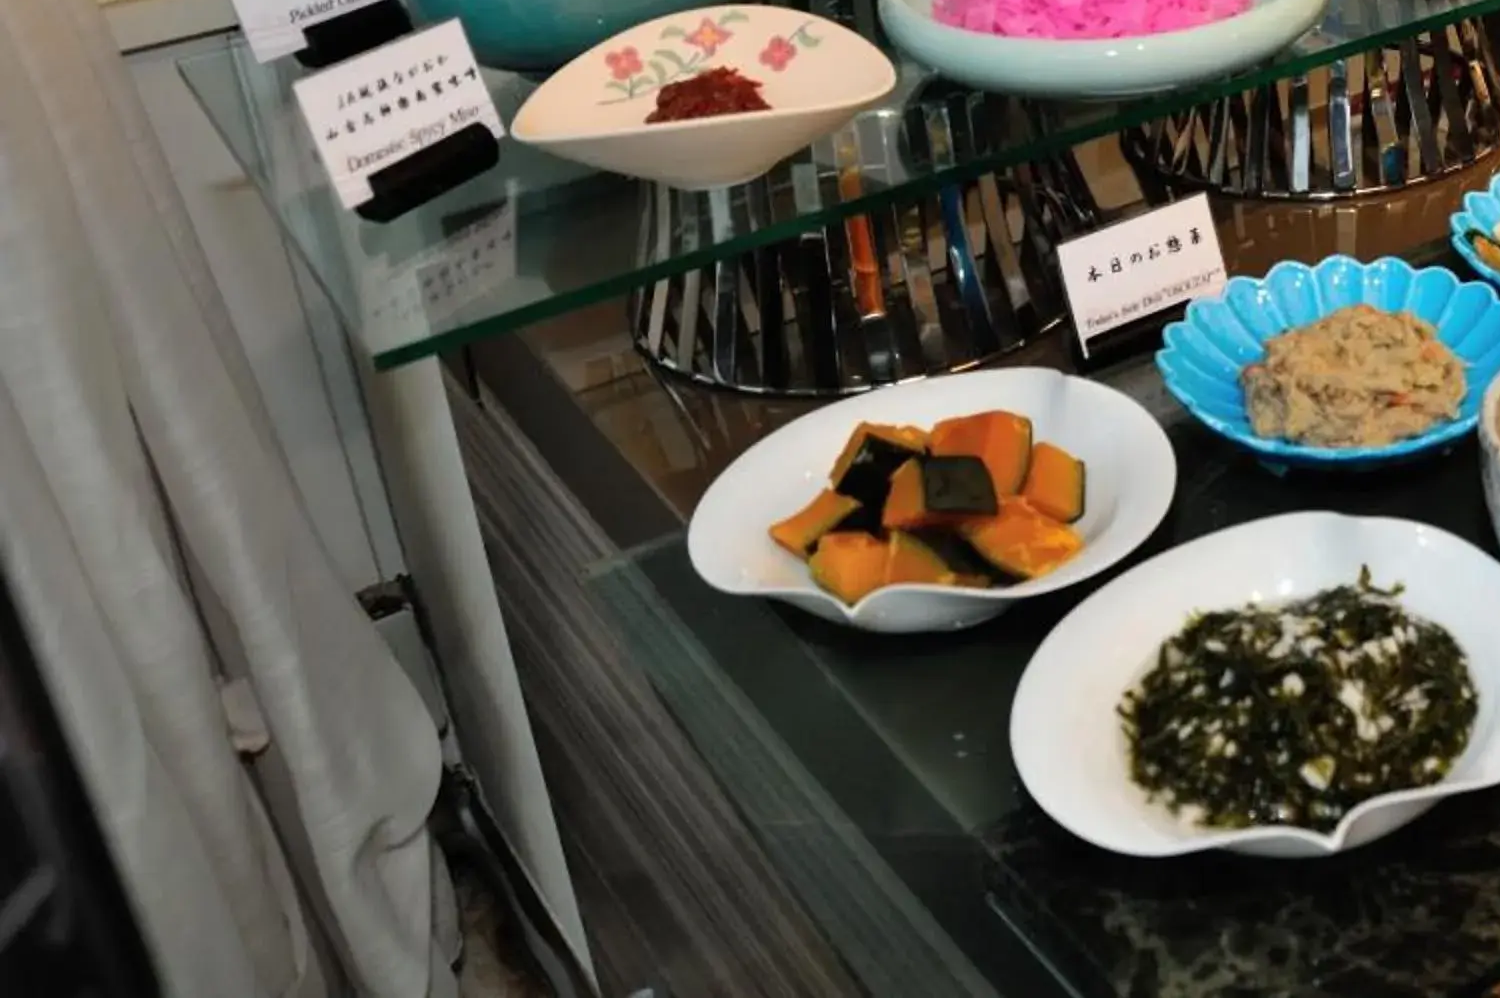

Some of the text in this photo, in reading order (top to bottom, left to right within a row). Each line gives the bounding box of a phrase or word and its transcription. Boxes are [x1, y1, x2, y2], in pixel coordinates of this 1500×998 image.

[289, 2, 334, 24] Pickled
[347, 138, 406, 173] Domestic
[449, 105, 480, 123] Miso
[1087, 227, 1204, 283] 本日のお惣菜
